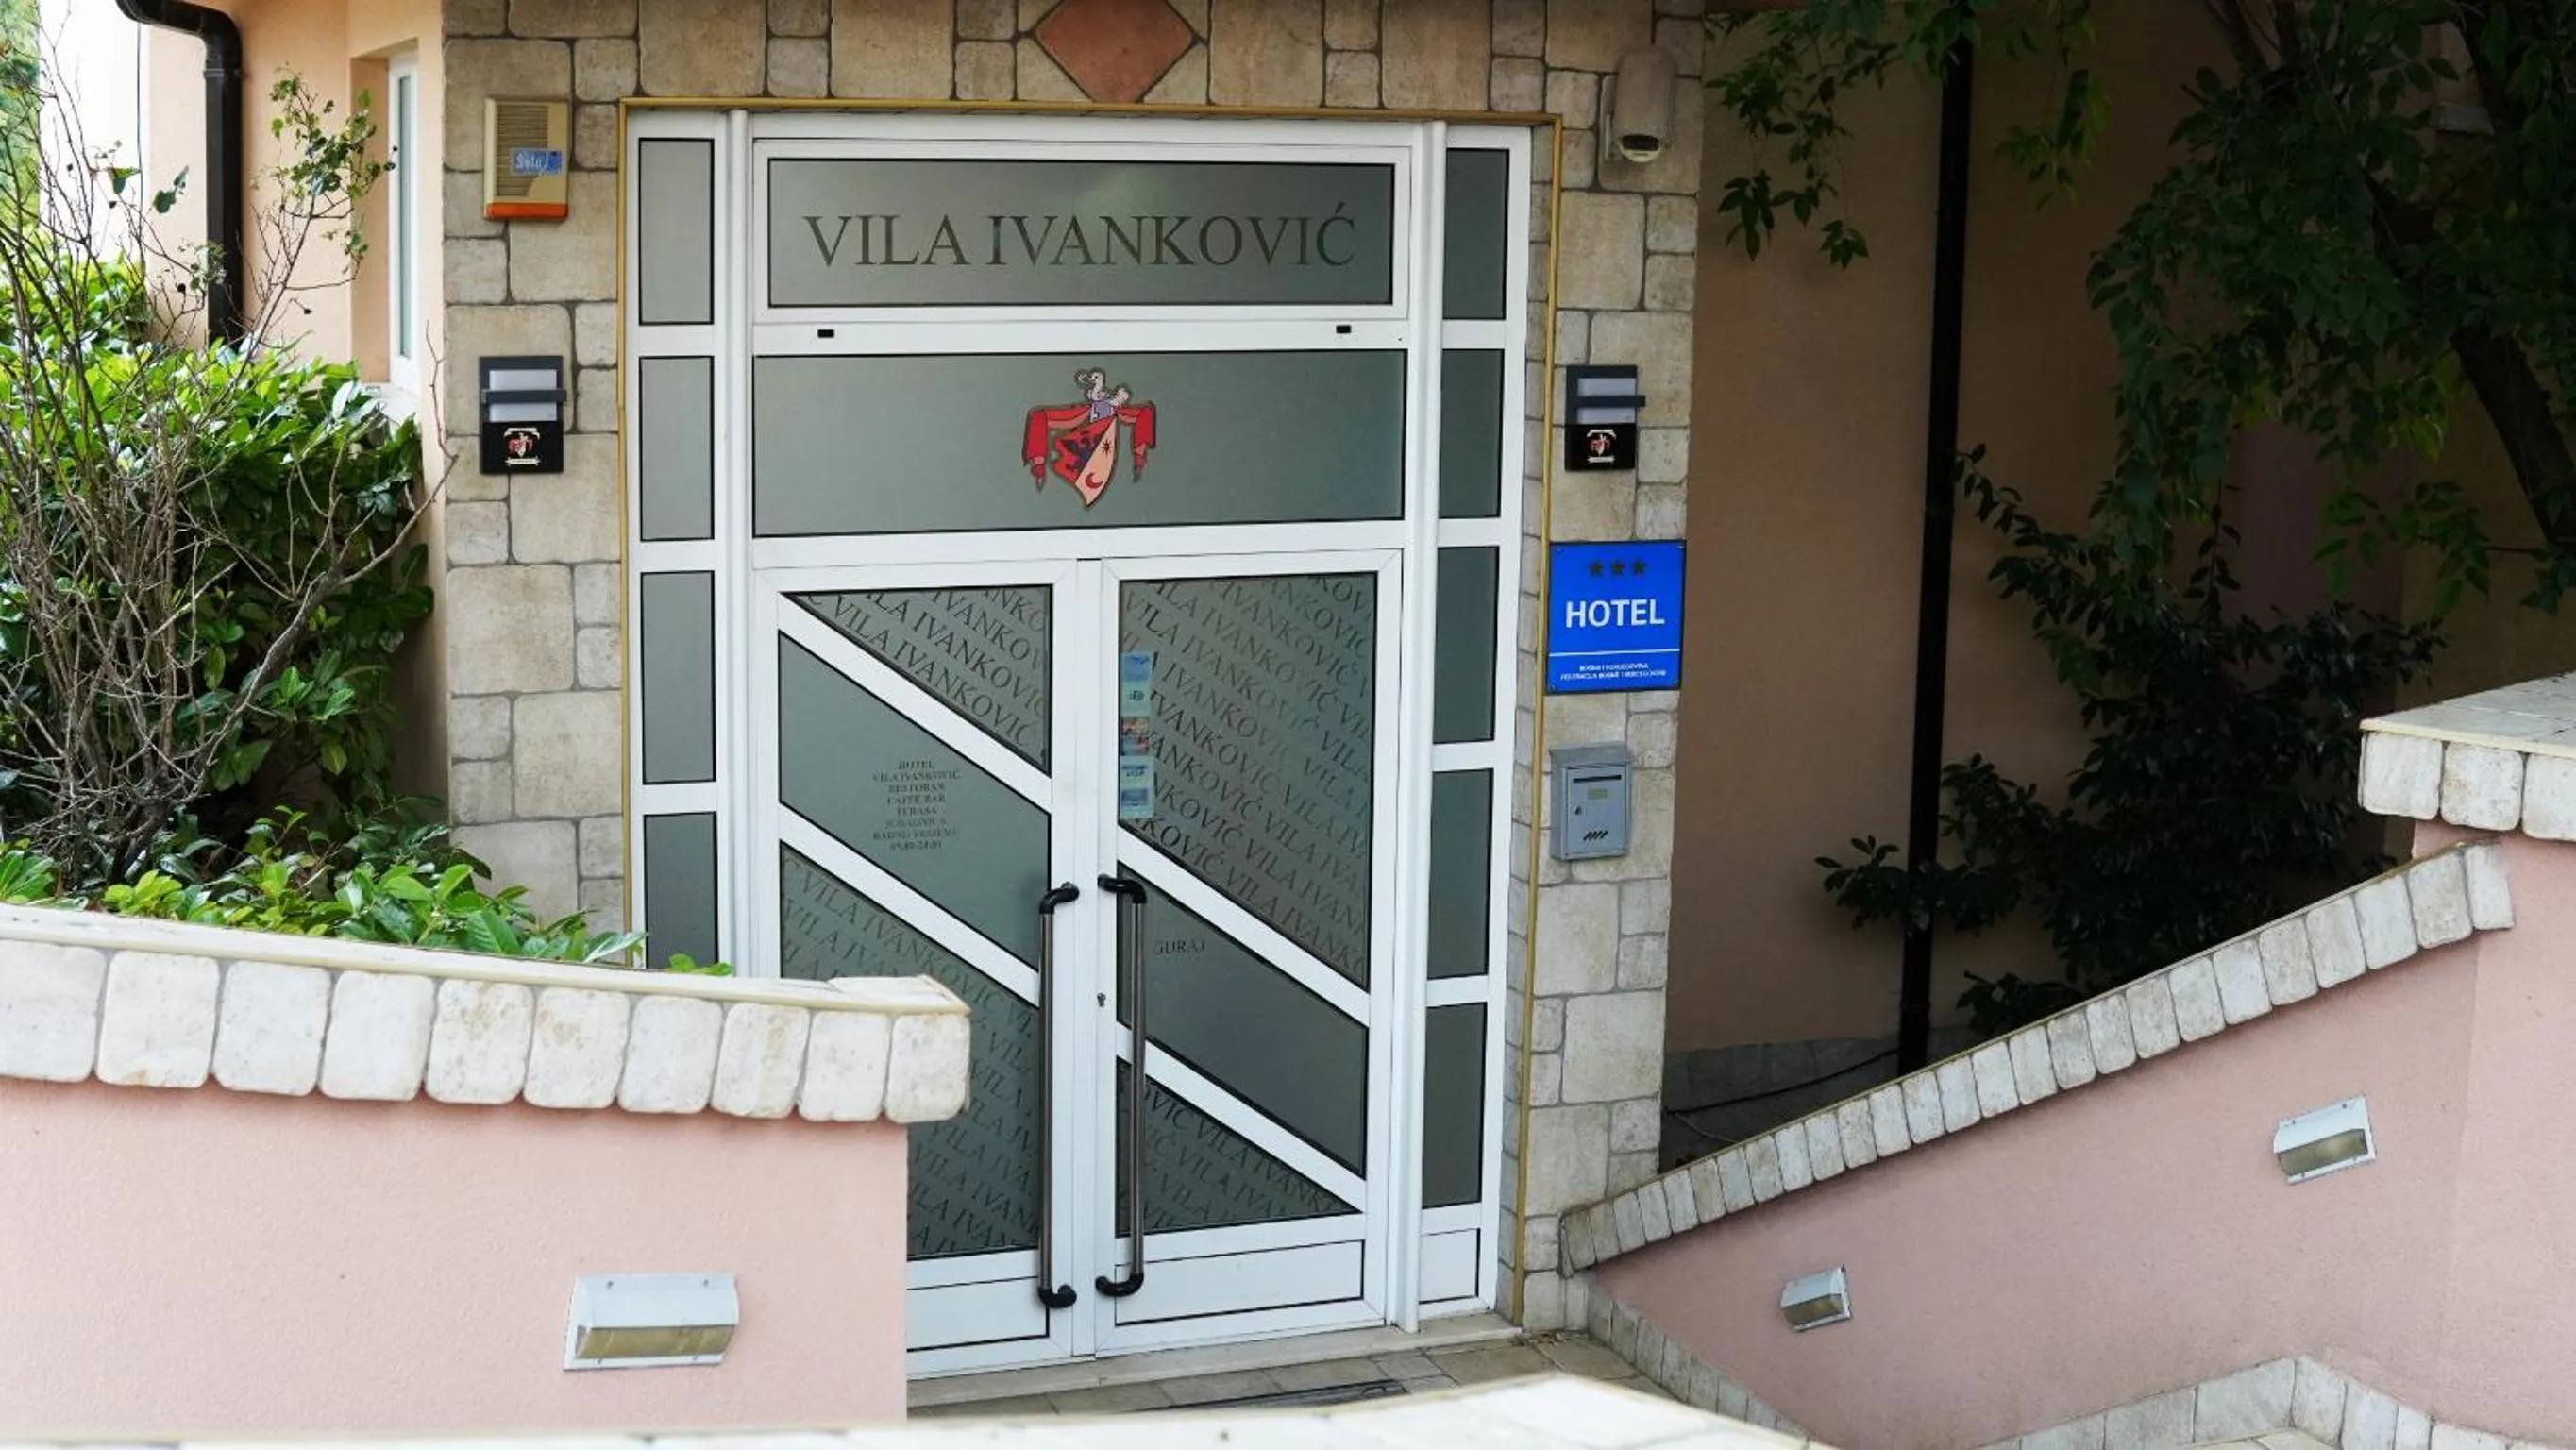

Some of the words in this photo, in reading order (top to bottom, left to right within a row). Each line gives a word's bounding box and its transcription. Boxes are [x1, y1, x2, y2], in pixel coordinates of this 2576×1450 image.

[803, 214, 970, 267] VILA
[986, 201, 1356, 267] IVANKOVIĆ
[834, 595, 890, 651] VILA
[1565, 599, 1665, 628] HOTEL
[1284, 784, 1335, 838] VILA
[1246, 837, 1297, 891] VILA
[1265, 810, 1317, 867] VILA
[804, 870, 857, 925] VILA
[1227, 866, 1279, 917] VILA
[1179, 1144, 1230, 1195] VILA
